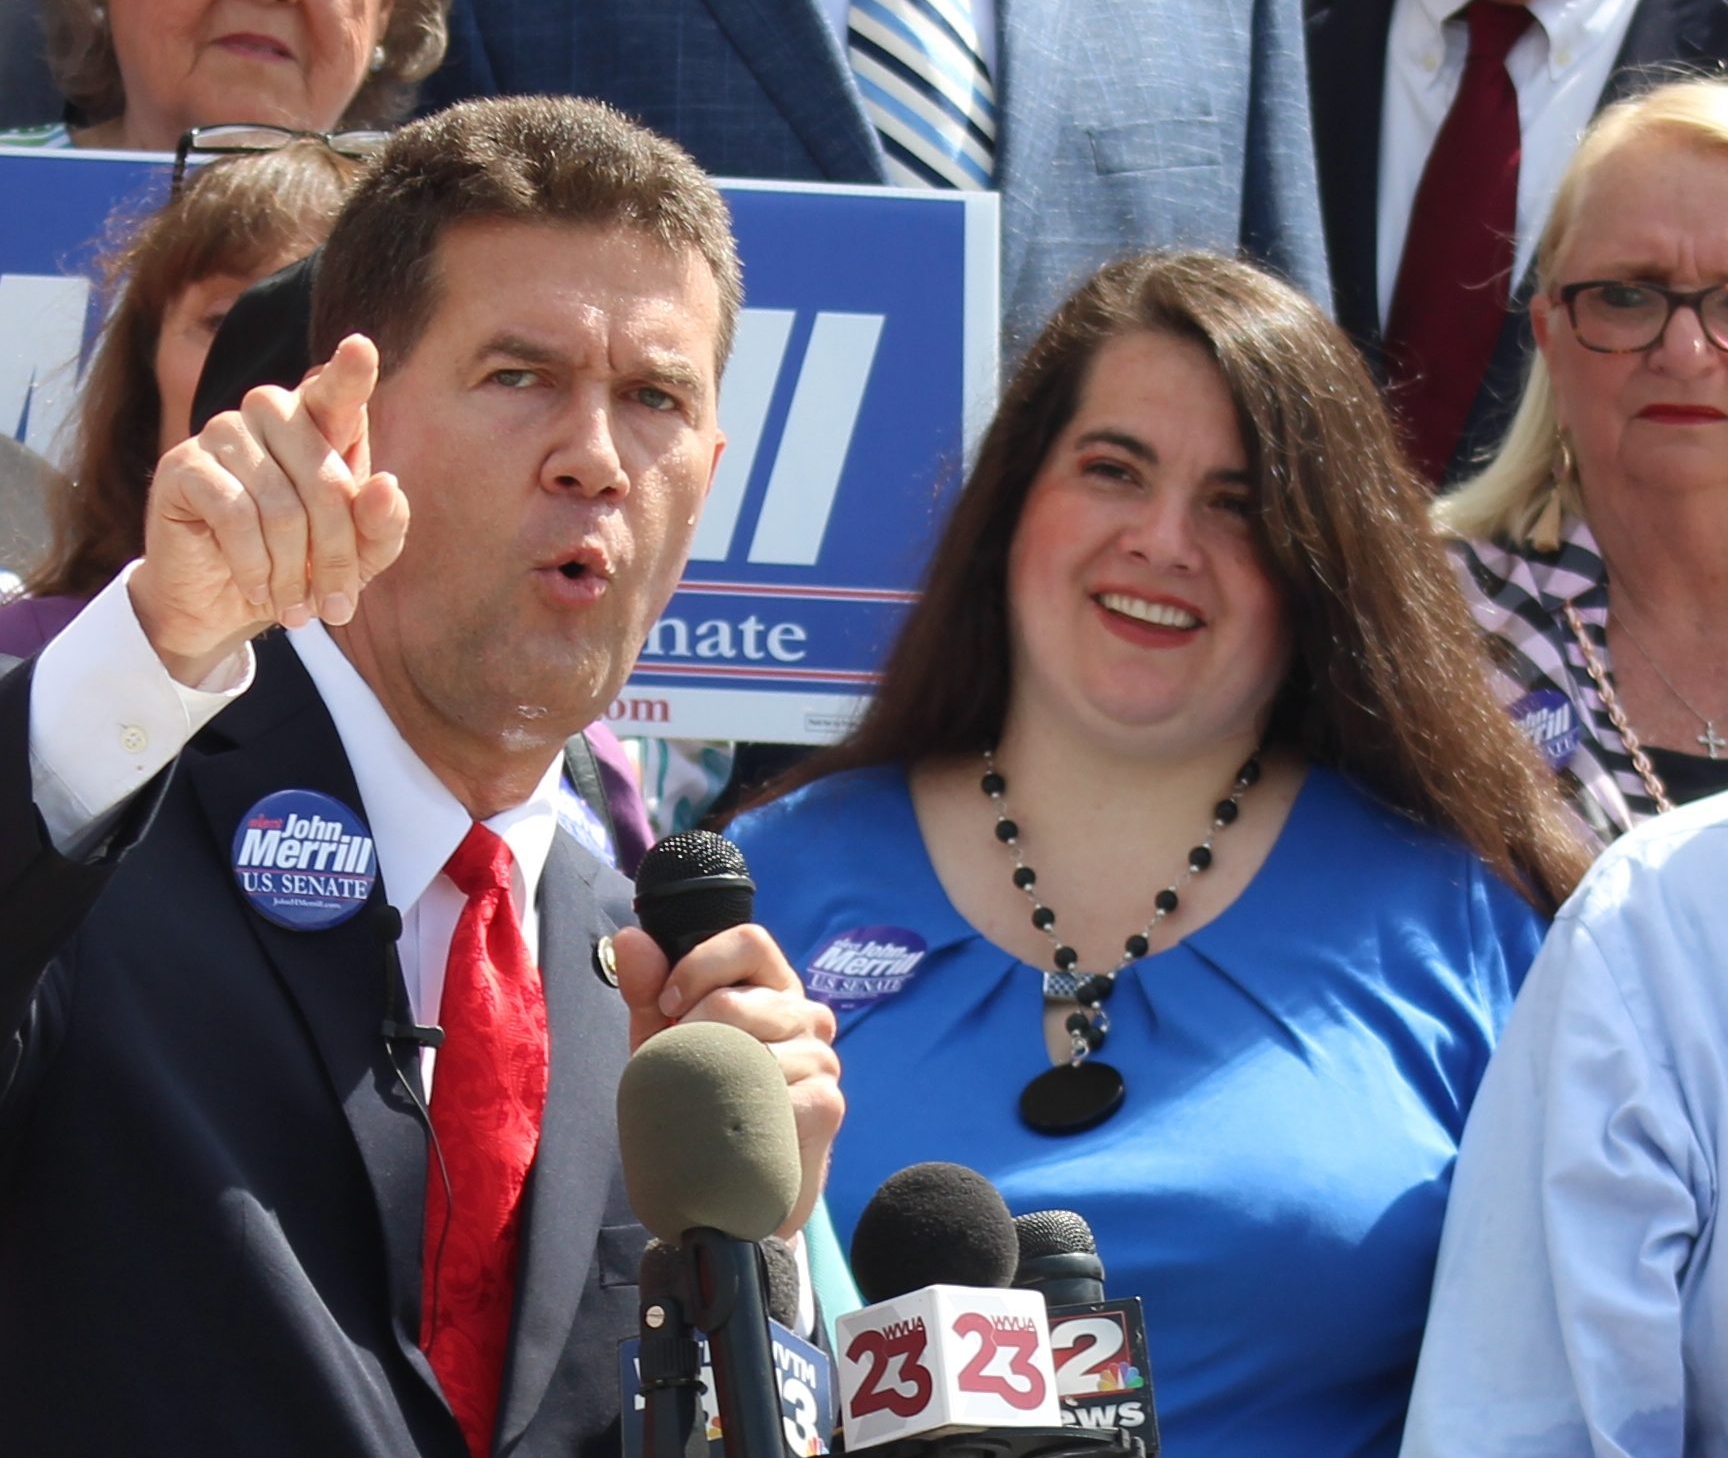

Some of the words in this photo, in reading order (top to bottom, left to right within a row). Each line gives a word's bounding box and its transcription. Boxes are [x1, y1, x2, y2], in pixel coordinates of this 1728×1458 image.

[642, 615, 808, 662] nate
[282, 814, 343, 841] John
[238, 829, 373, 874] Merrill
[243, 873, 277, 893] U.S.
[282, 874, 368, 900] SENATE
[813, 947, 925, 976] Merrill
[859, 940, 908, 958] John
[881, 1315, 925, 1341] WVUA
[991, 1315, 1035, 1333] WVUA
[845, 1325, 932, 1418] 23
[952, 1312, 1046, 1410] 23
[1062, 1402, 1145, 1429] ews
